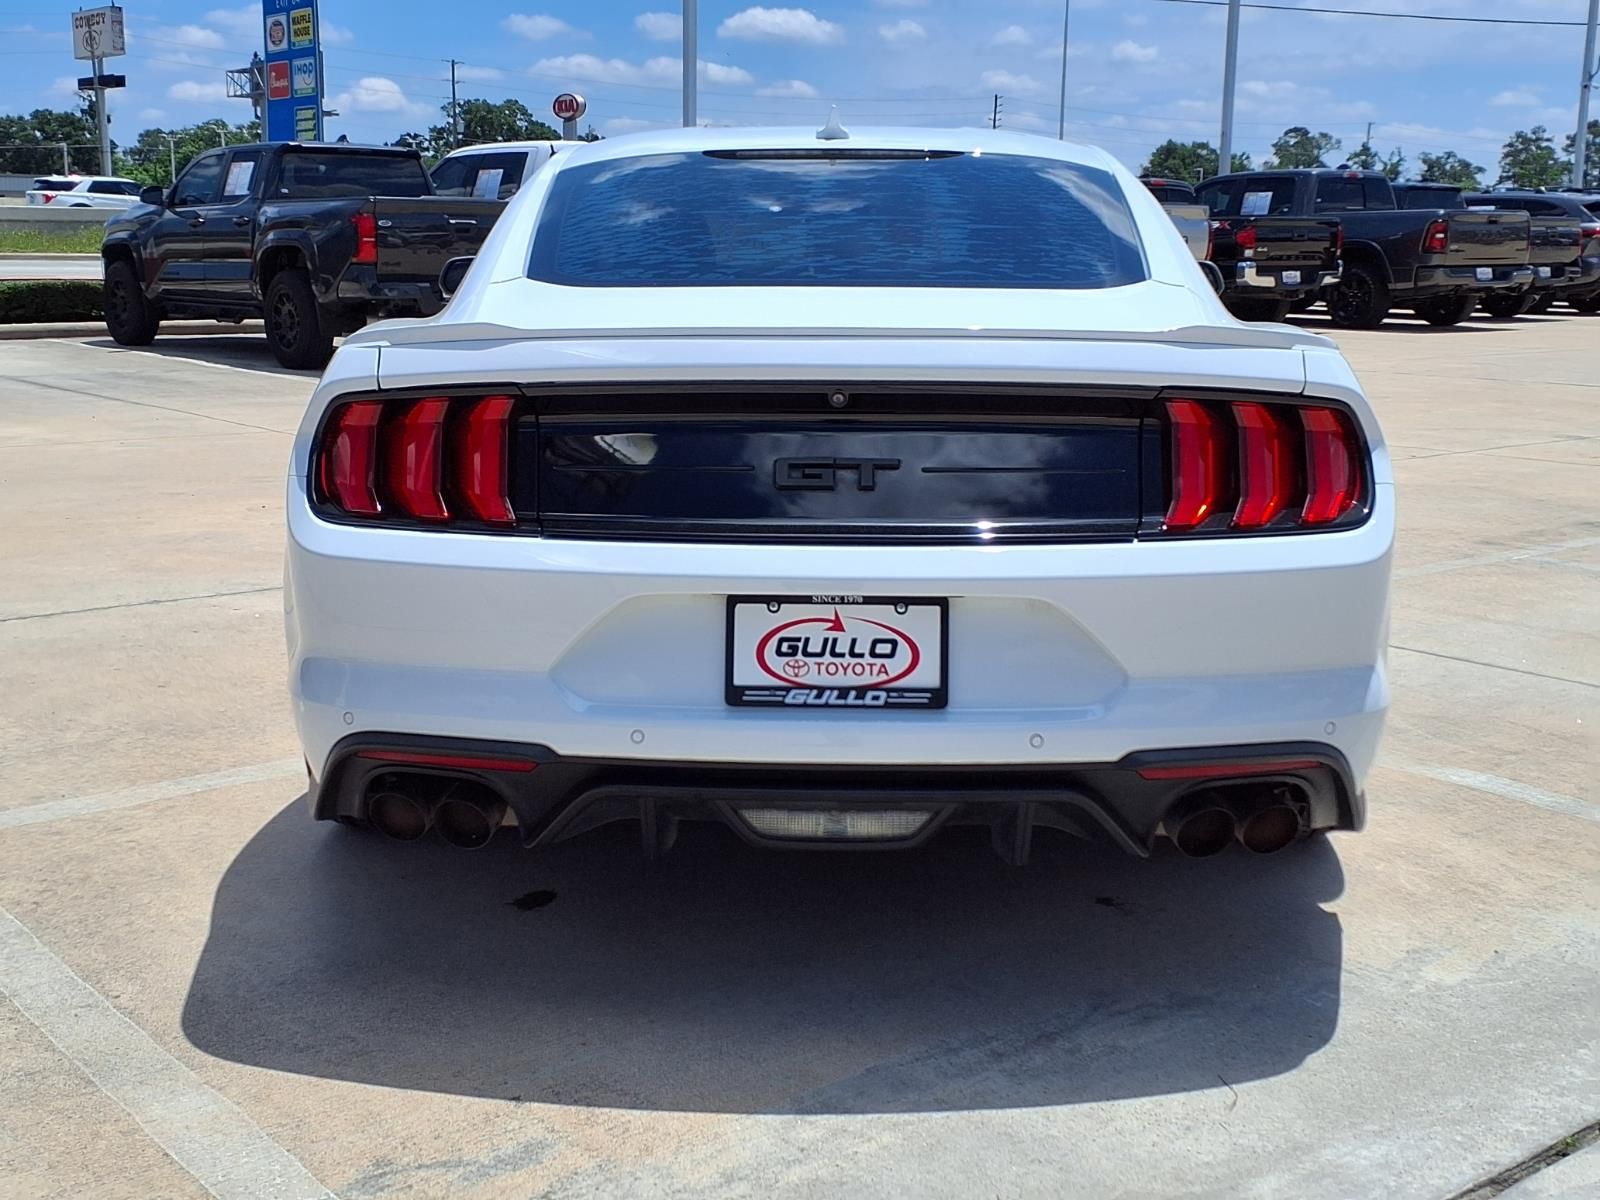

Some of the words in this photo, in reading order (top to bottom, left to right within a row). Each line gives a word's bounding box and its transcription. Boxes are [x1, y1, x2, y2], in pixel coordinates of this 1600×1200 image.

[75, 12, 106, 29] COWBOY
[292, 13, 311, 26] WAFFLE
[293, 26, 311, 38] HOUSE
[557, 99, 577, 113] KIA
[774, 457, 901, 491] GT
[812, 595, 841, 603] SINCE
[775, 637, 898, 659] GULLO
[814, 662, 889, 677] TOYOTA
[784, 689, 887, 706] GULLO
